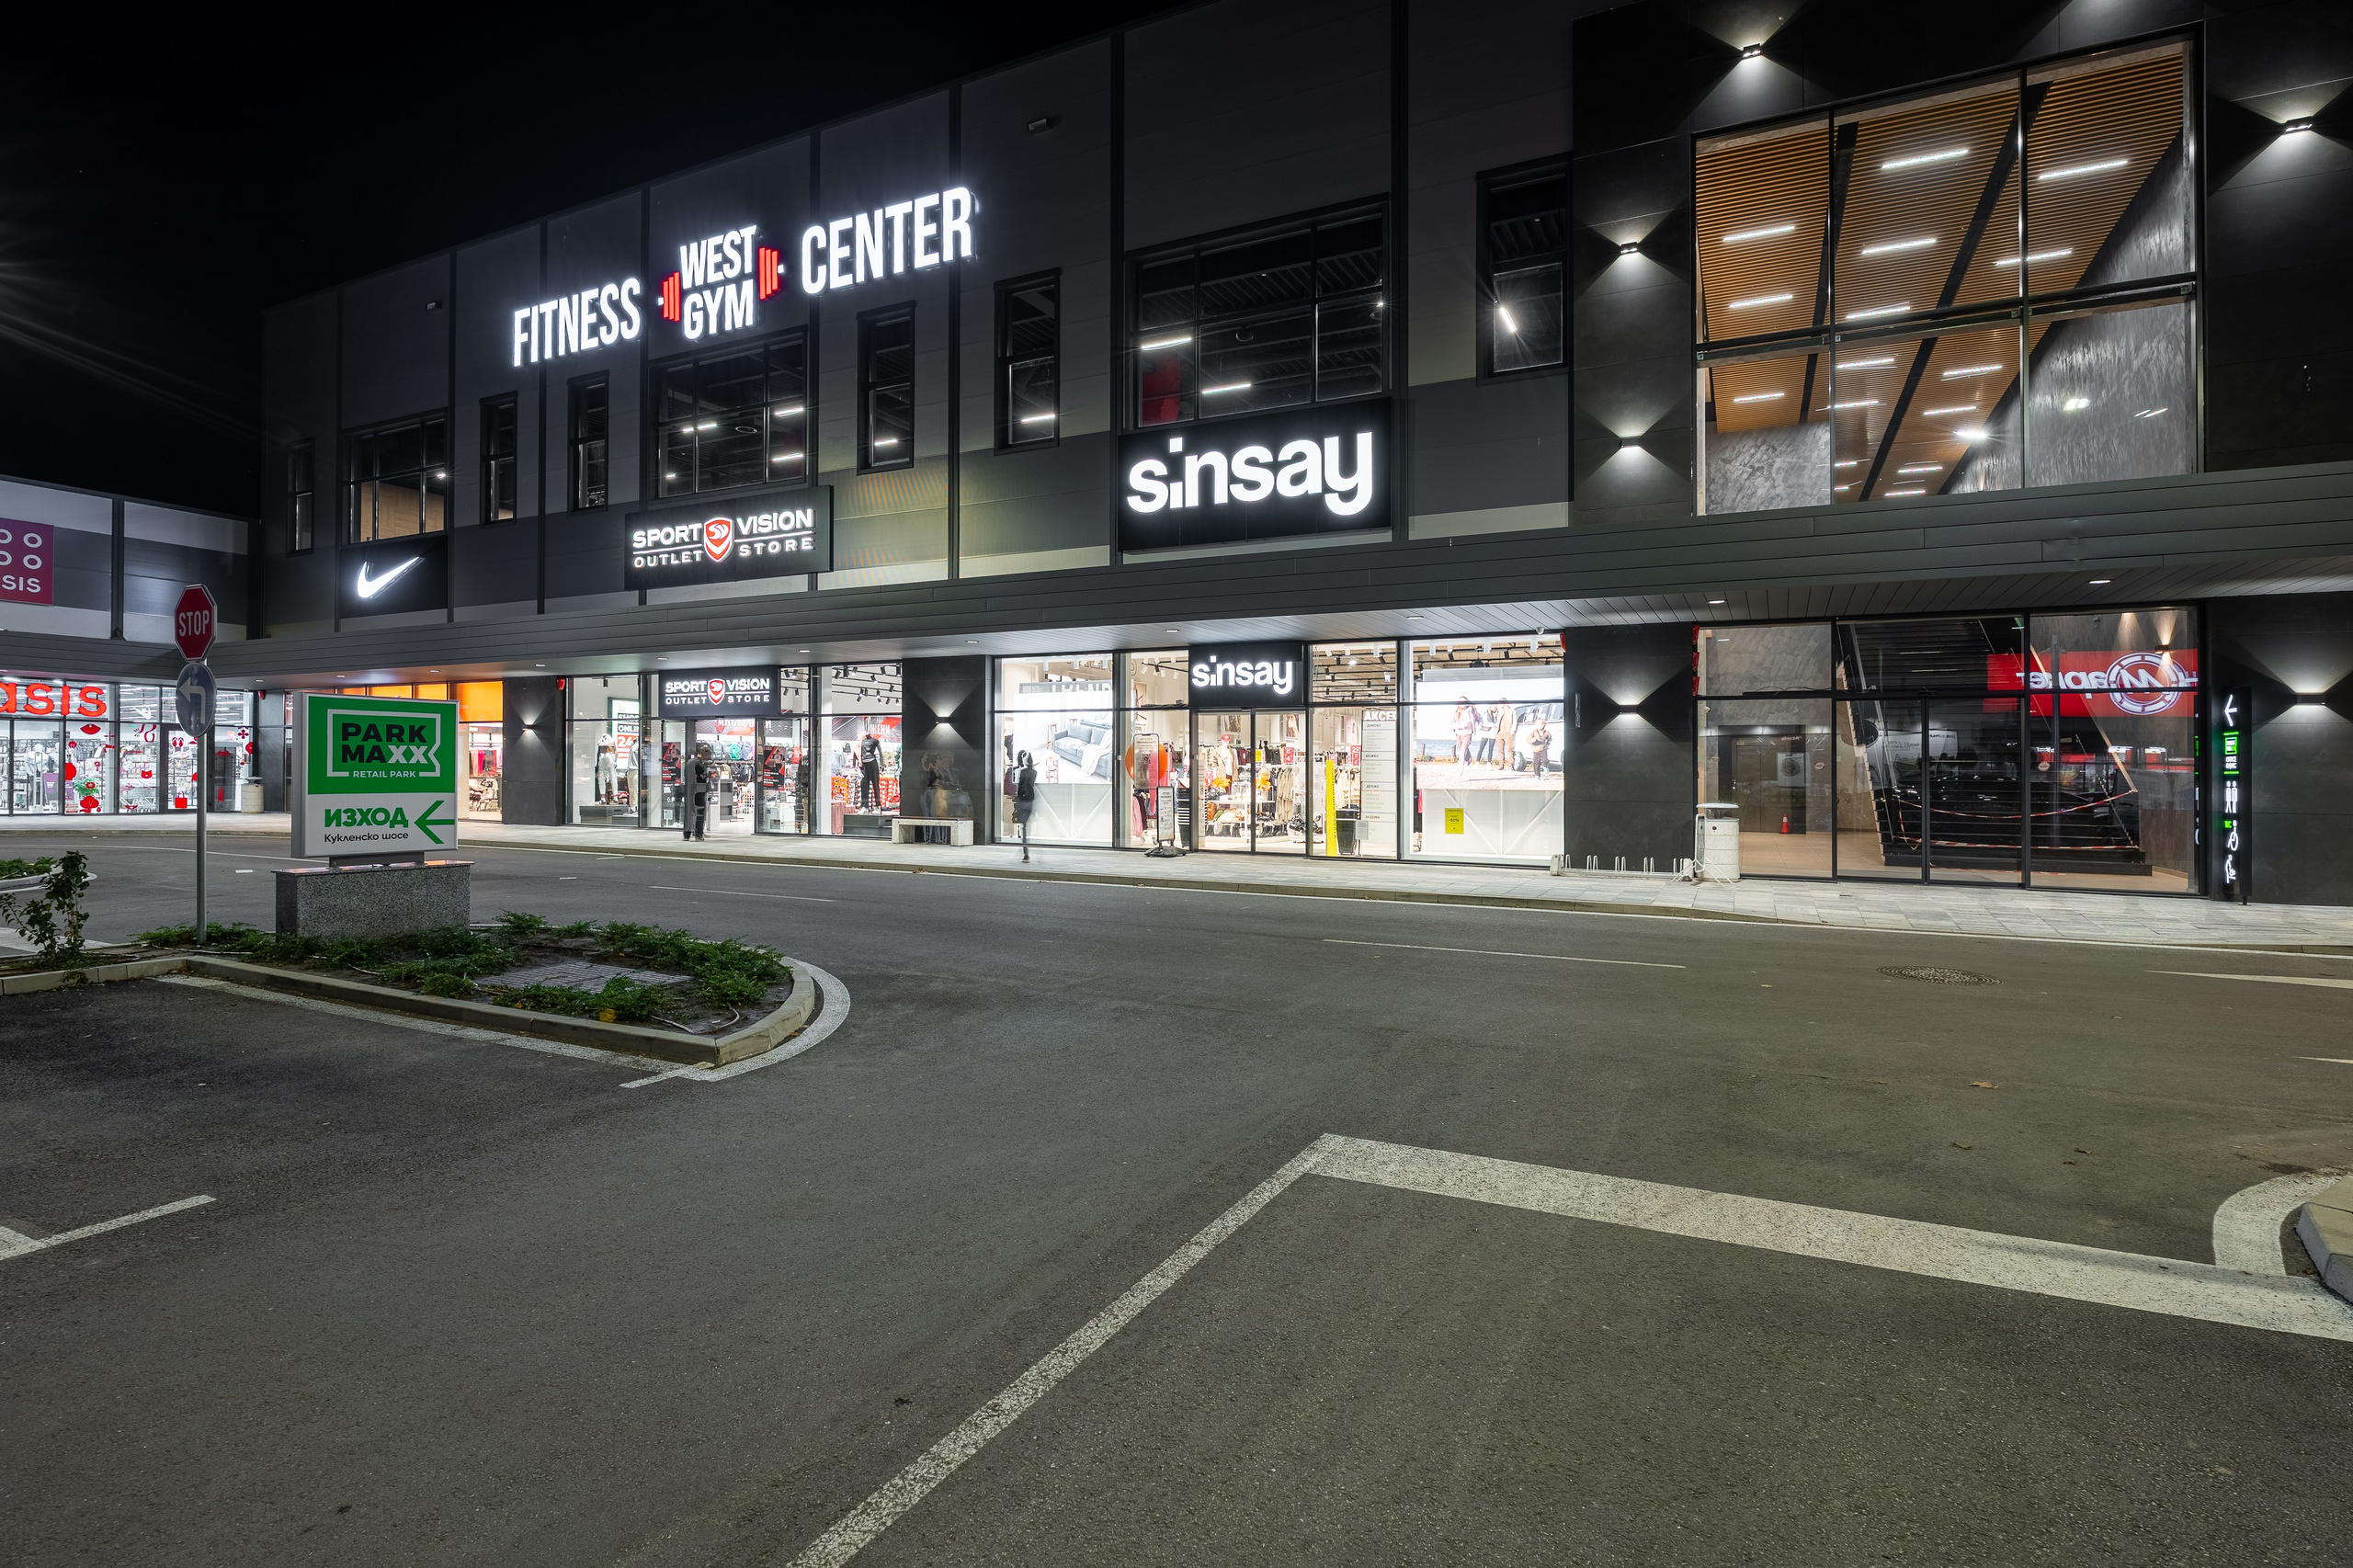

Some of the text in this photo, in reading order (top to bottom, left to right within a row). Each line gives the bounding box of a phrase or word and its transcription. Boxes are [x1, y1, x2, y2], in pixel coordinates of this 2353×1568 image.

[801, 187, 974, 296] CENTER
[680, 225, 756, 289] WEST
[513, 278, 641, 367] FITNESS
[683, 278, 754, 340] GYM
[1127, 430, 1373, 516] sinsay
[632, 508, 813, 549] SPORT VISION
[634, 538, 813, 568] OUTLET STORE
[178, 609, 210, 637] STOP
[665, 678, 770, 693] SPORT VISION
[1192, 655, 1293, 695] sinsay
[665, 695, 770, 705] OUTLET STORE
[342, 722, 427, 743] PARK
[342, 744, 428, 764] MAXX
[324, 807, 409, 828] ИЗХОД
[324, 832, 409, 844] Кукленско шосе
